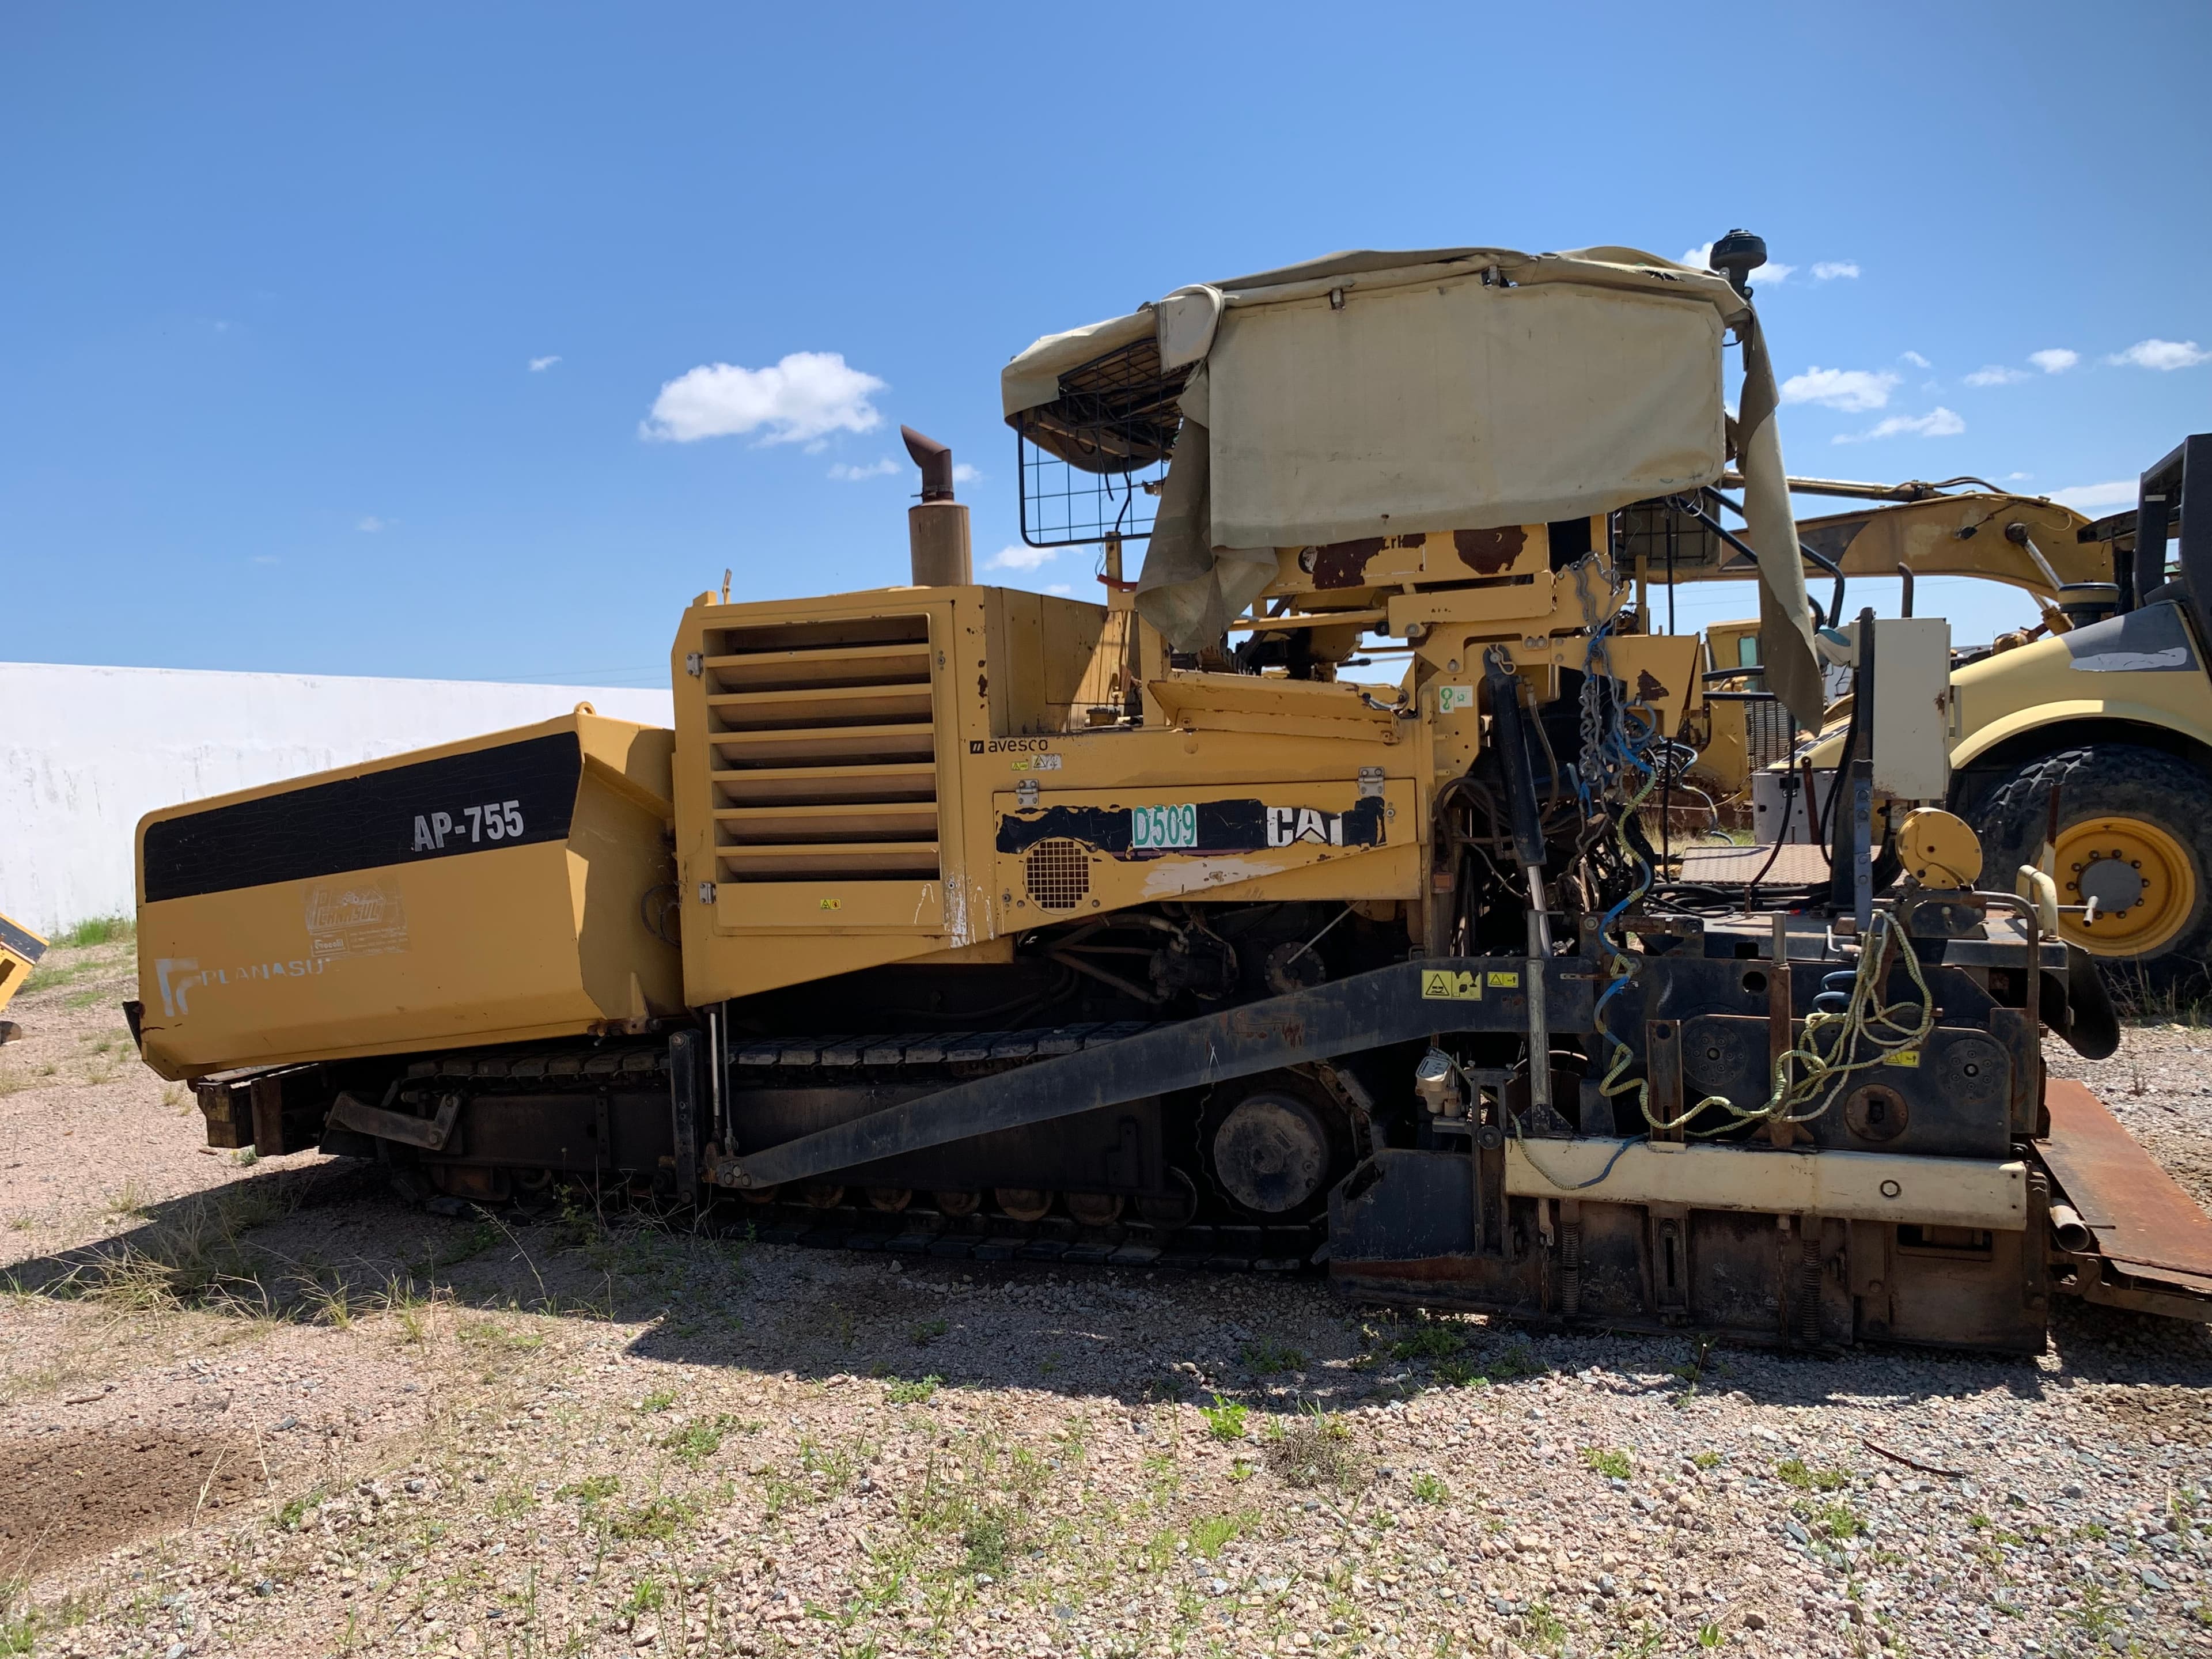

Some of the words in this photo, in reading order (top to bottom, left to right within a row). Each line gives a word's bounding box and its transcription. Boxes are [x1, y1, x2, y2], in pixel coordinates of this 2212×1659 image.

[988, 739, 1048, 752] avesco
[414, 800, 524, 852] AP-755
[1134, 805, 1195, 846] D509
[199, 957, 334, 986] PLANASU
